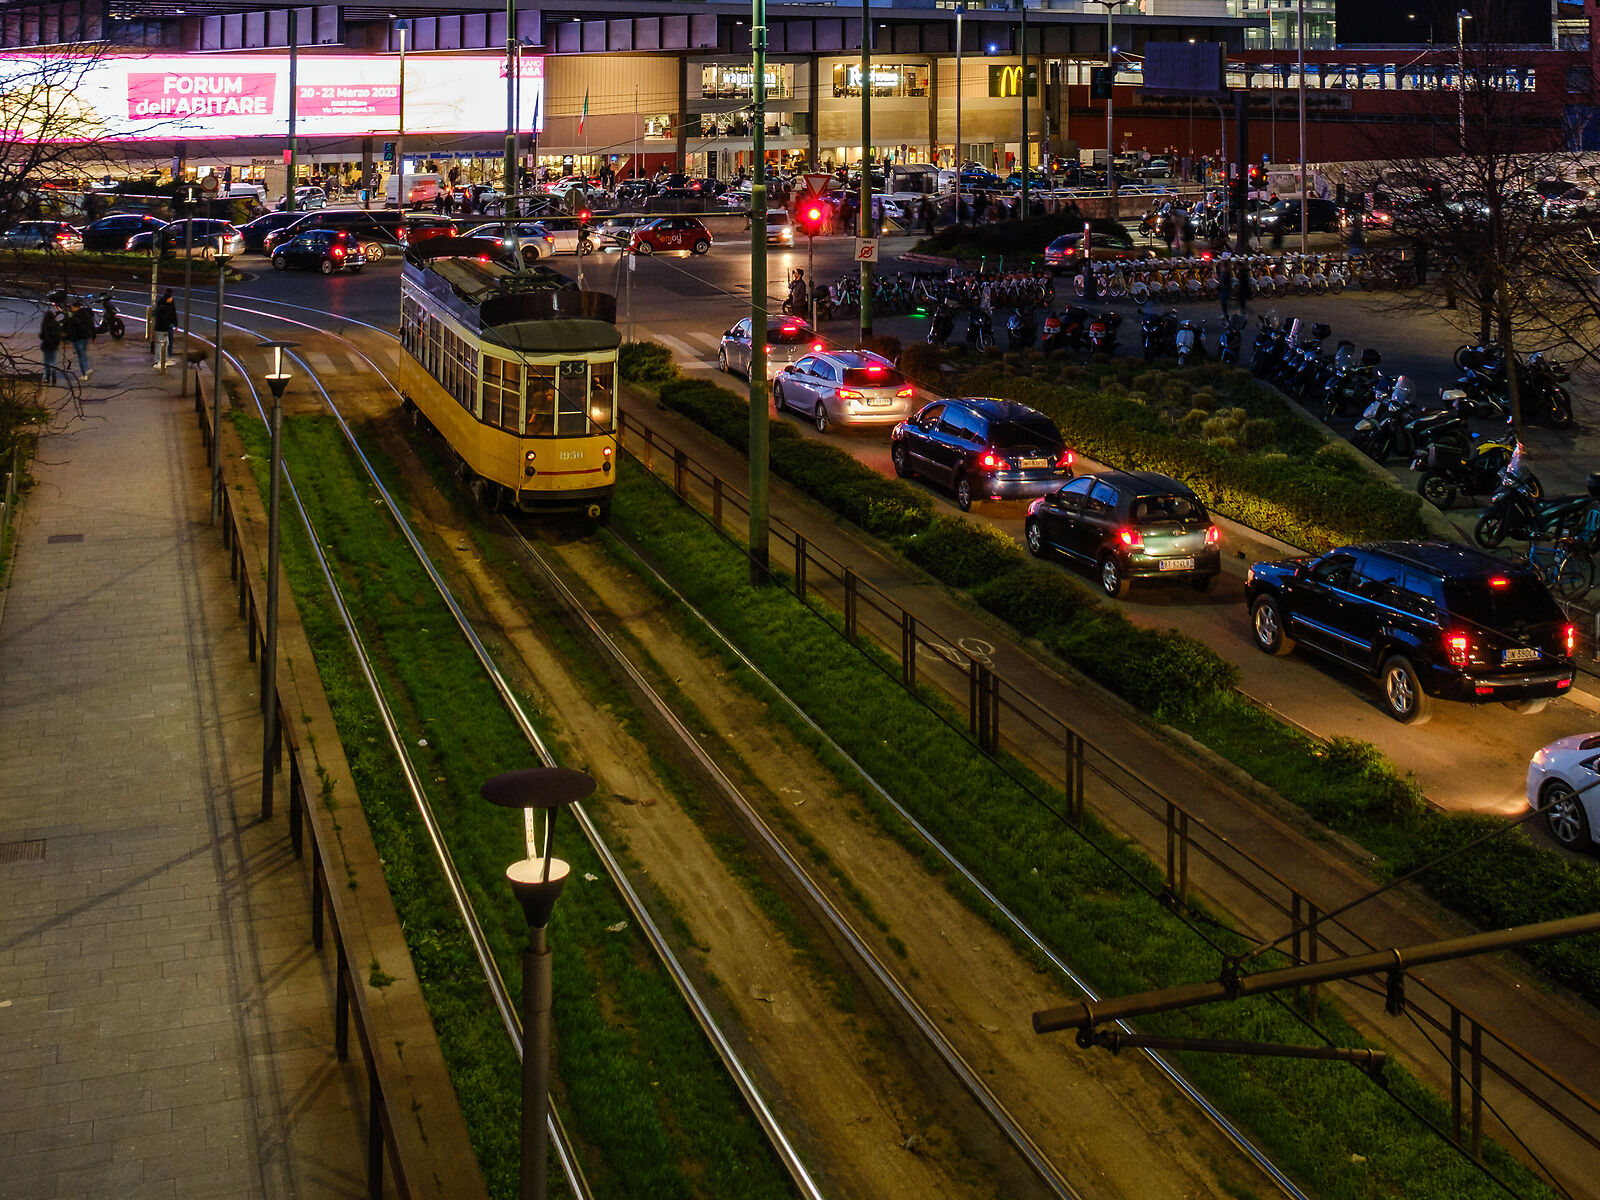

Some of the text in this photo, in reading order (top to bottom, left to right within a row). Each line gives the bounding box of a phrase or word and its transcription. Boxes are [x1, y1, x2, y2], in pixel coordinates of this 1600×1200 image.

[163, 76, 243, 94] FORUM
[300, 87, 315, 98] 20
[321, 87, 335, 98] 22
[336, 87, 370, 98] Marzo
[371, 87, 398, 98] 2023
[135, 97, 268, 115] dell'ABITARE
[561, 362, 585, 376] 33
[559, 451, 584, 461] 1950
